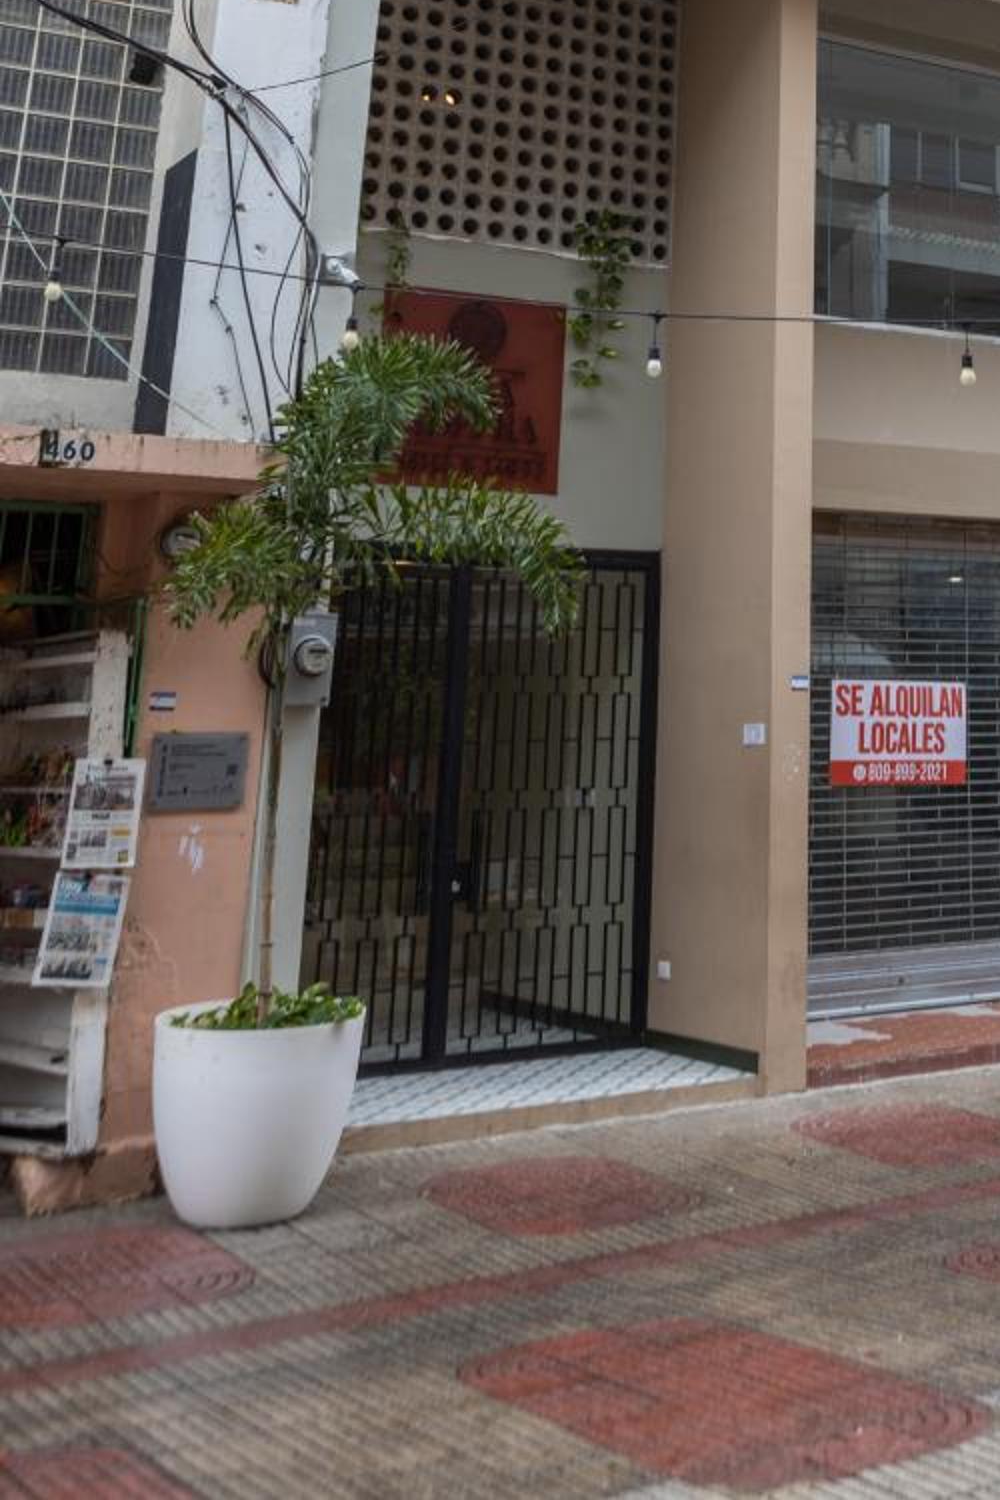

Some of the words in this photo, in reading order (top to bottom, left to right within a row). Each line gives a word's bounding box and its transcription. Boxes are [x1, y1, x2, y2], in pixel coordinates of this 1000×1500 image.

[835, 684, 864, 716] SE
[869, 685, 962, 718] ALQUILAN
[858, 721, 945, 754] LOCALES
